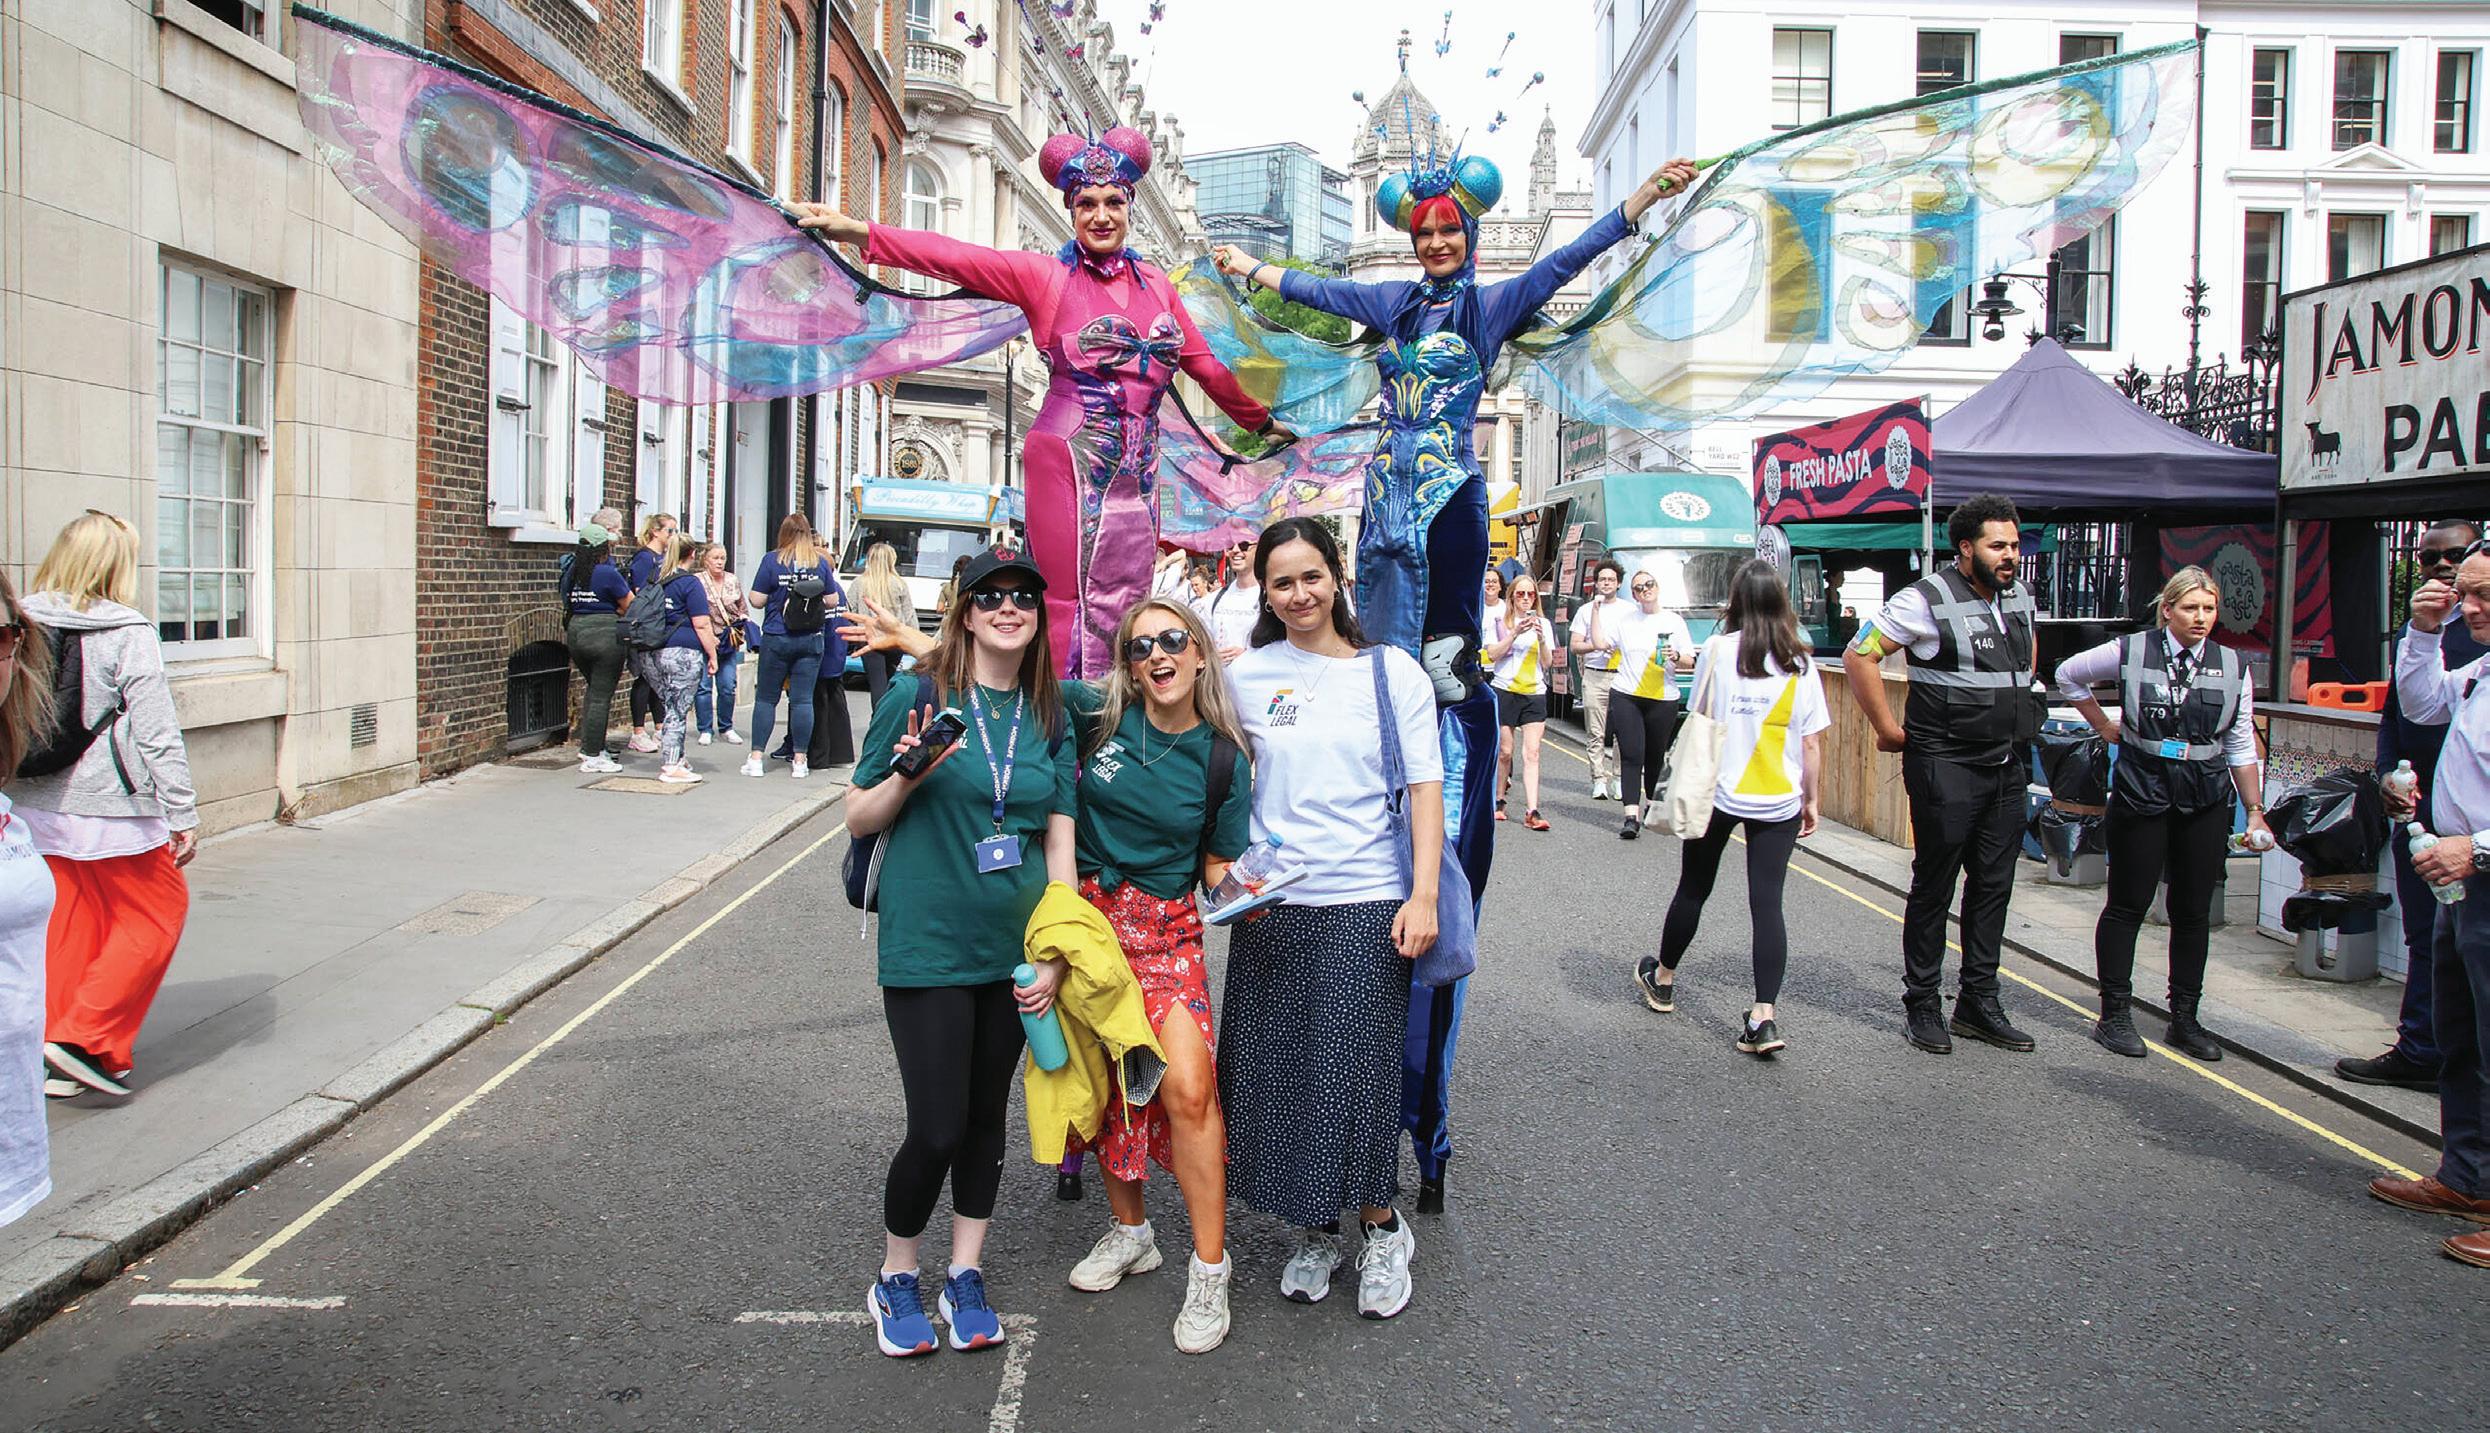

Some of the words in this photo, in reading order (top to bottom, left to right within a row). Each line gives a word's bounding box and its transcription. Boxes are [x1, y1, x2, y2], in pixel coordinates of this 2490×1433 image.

[1789, 456, 1825, 490] FRESH
[1828, 448, 1872, 484] PASTA
[2217, 559, 2257, 592] pasta
[2222, 588, 2259, 621] basta
[1974, 637, 1995, 650] 140
[1275, 704, 1300, 715] FLEX
[2143, 707, 2166, 719] 179
[1270, 715, 1297, 727] LEGAL
